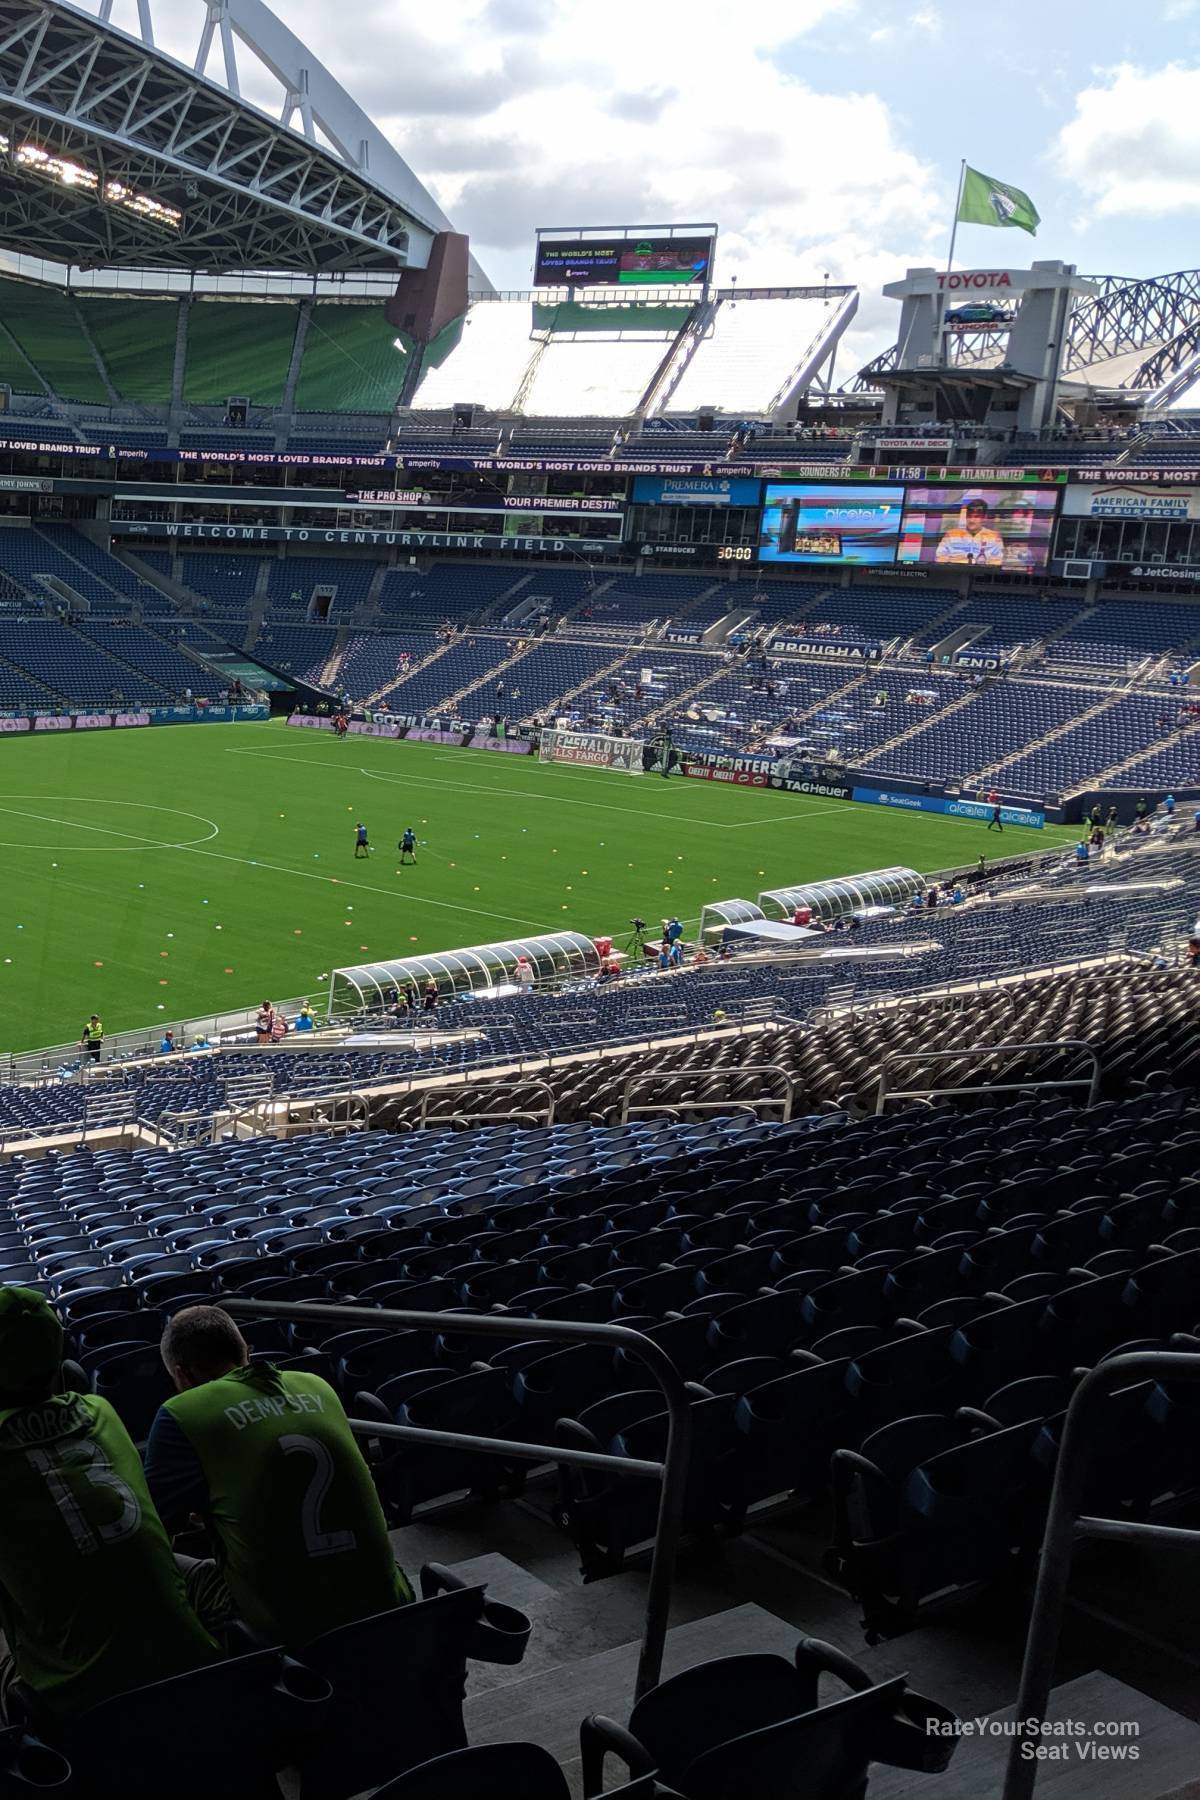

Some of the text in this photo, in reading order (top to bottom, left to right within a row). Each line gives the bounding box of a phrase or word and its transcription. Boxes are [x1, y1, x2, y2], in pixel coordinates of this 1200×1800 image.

[936, 272, 1013, 289] TOYOTA
[9, 441, 37, 450] LOVED
[39, 443, 73, 453] BRANDS
[75, 446, 101, 455] TRUST
[118, 449, 148, 459] amperity
[178, 450, 387, 466] THE WORLD'S MOST LOVED BRANDS TRUST
[407, 460, 441, 469] amperity
[472, 460, 693, 473] THE WORLD'S MOST LOVED BRANDS TRUST
[716, 465, 752, 476] amperity
[799, 466, 876, 478] SOUNDERS FC 0
[895, 467, 921, 479] 11:58
[939, 468, 1025, 481] 0 ATLANTA UNITED
[1078, 471, 1199, 481] THE WORLD'S MOST
[17, 480, 40, 489] JOHN'S
[663, 479, 714, 491] PREMERA
[358, 490, 376, 500] THE
[377, 490, 396, 501] PRO
[397, 491, 422, 501] SHOP
[503, 497, 619, 510] YOUR PREMIER DESTIN
[1092, 498, 1190, 508] AMERICAN FAMILY
[1098, 507, 1181, 516] INSURANCE
[166, 525, 565, 551] WELCOME TO CENTURYLINK FIELD
[655, 545, 696, 554] STARBUCKS
[717, 546, 752, 560] 30:00
[900, 569, 928, 578] ELECTRIC
[1143, 566, 1200, 581] JetClosing
[667, 633, 700, 644] THE
[958, 657, 998, 670] END
[372, 712, 471, 735] GORILLA FC
[557, 736, 611, 754] EMERALD
[613, 742, 642, 756] CITY
[541, 745, 609, 763] WELLS FARGO
[889, 796, 922, 808] SeatGeek
[949, 802, 988, 818] alcatel
[1000, 811, 1041, 825] alcatel
[222, 1391, 327, 1431] DEMPSEY
[277, 1433, 358, 1558] 2
